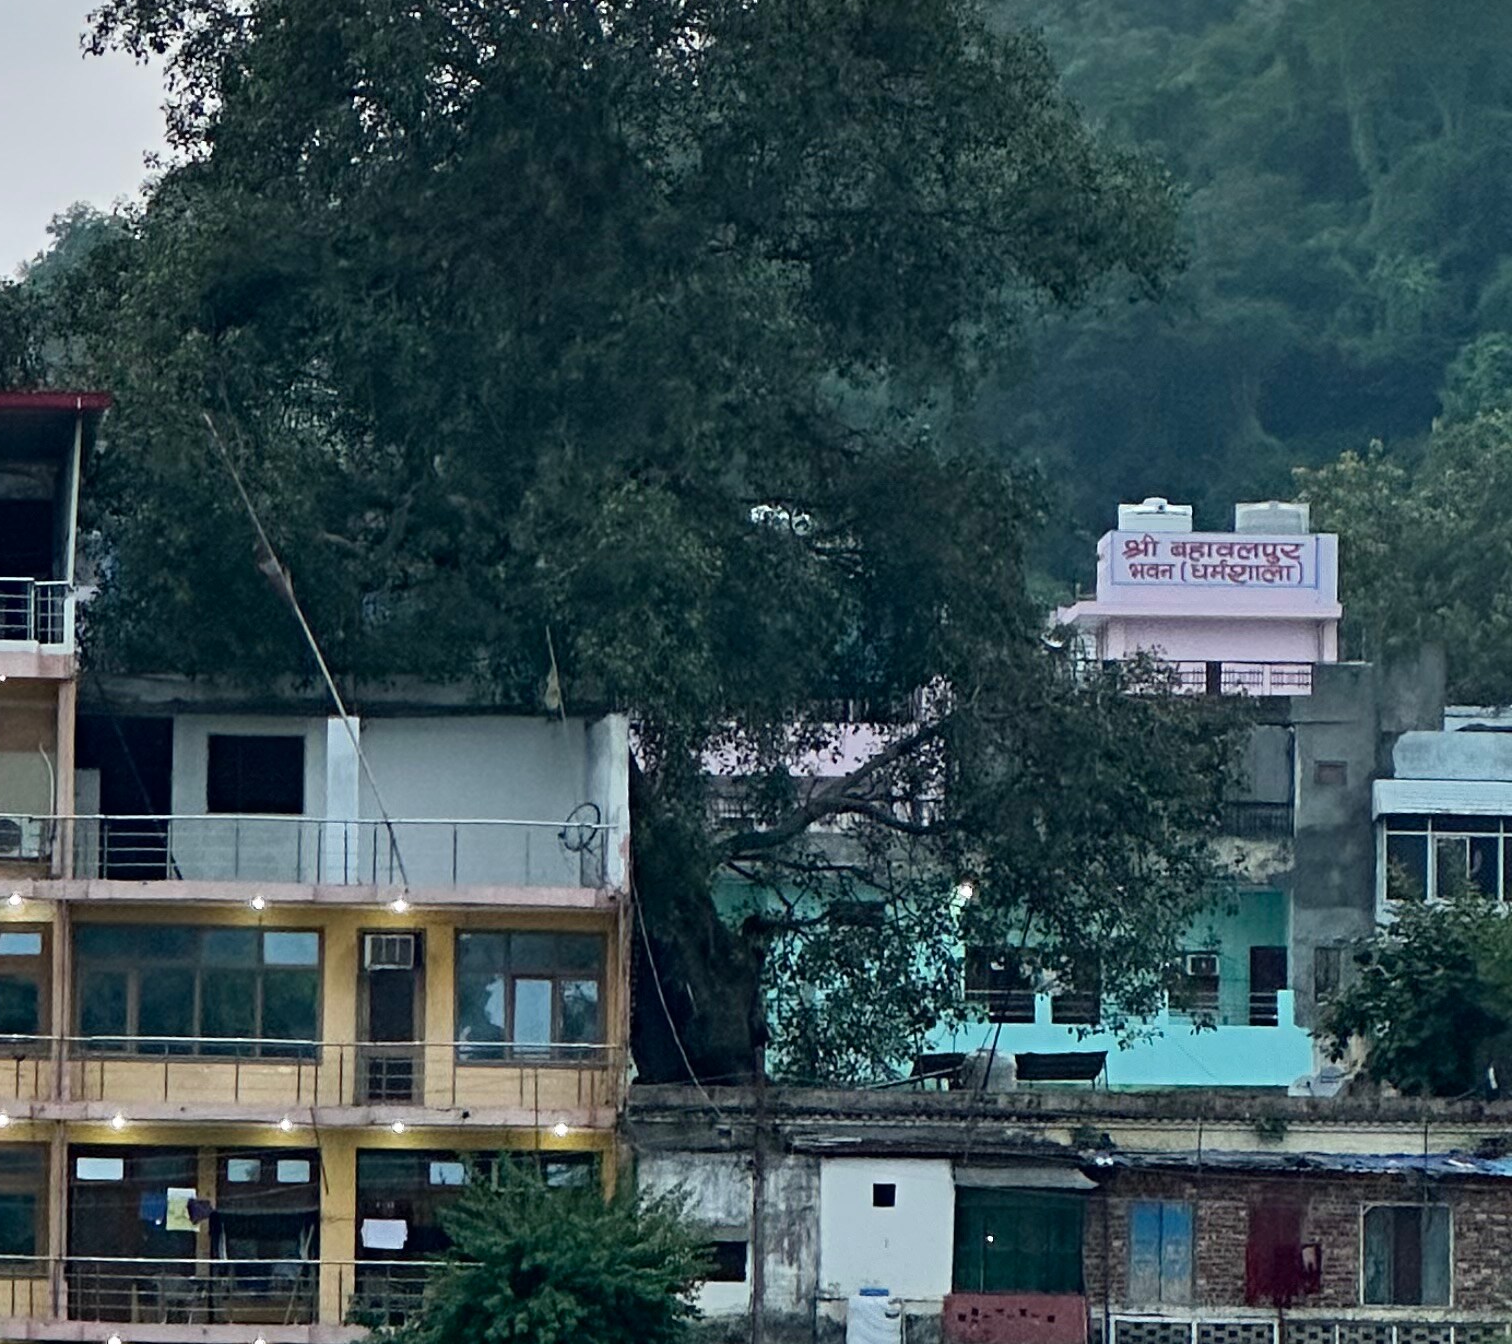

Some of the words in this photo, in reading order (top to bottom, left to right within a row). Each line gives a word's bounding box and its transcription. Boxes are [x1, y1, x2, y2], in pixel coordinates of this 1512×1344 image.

[1122, 533, 1160, 559] श्री
[1170, 541, 1304, 564] बहावलपुर
[1129, 563, 1176, 581] भवन
